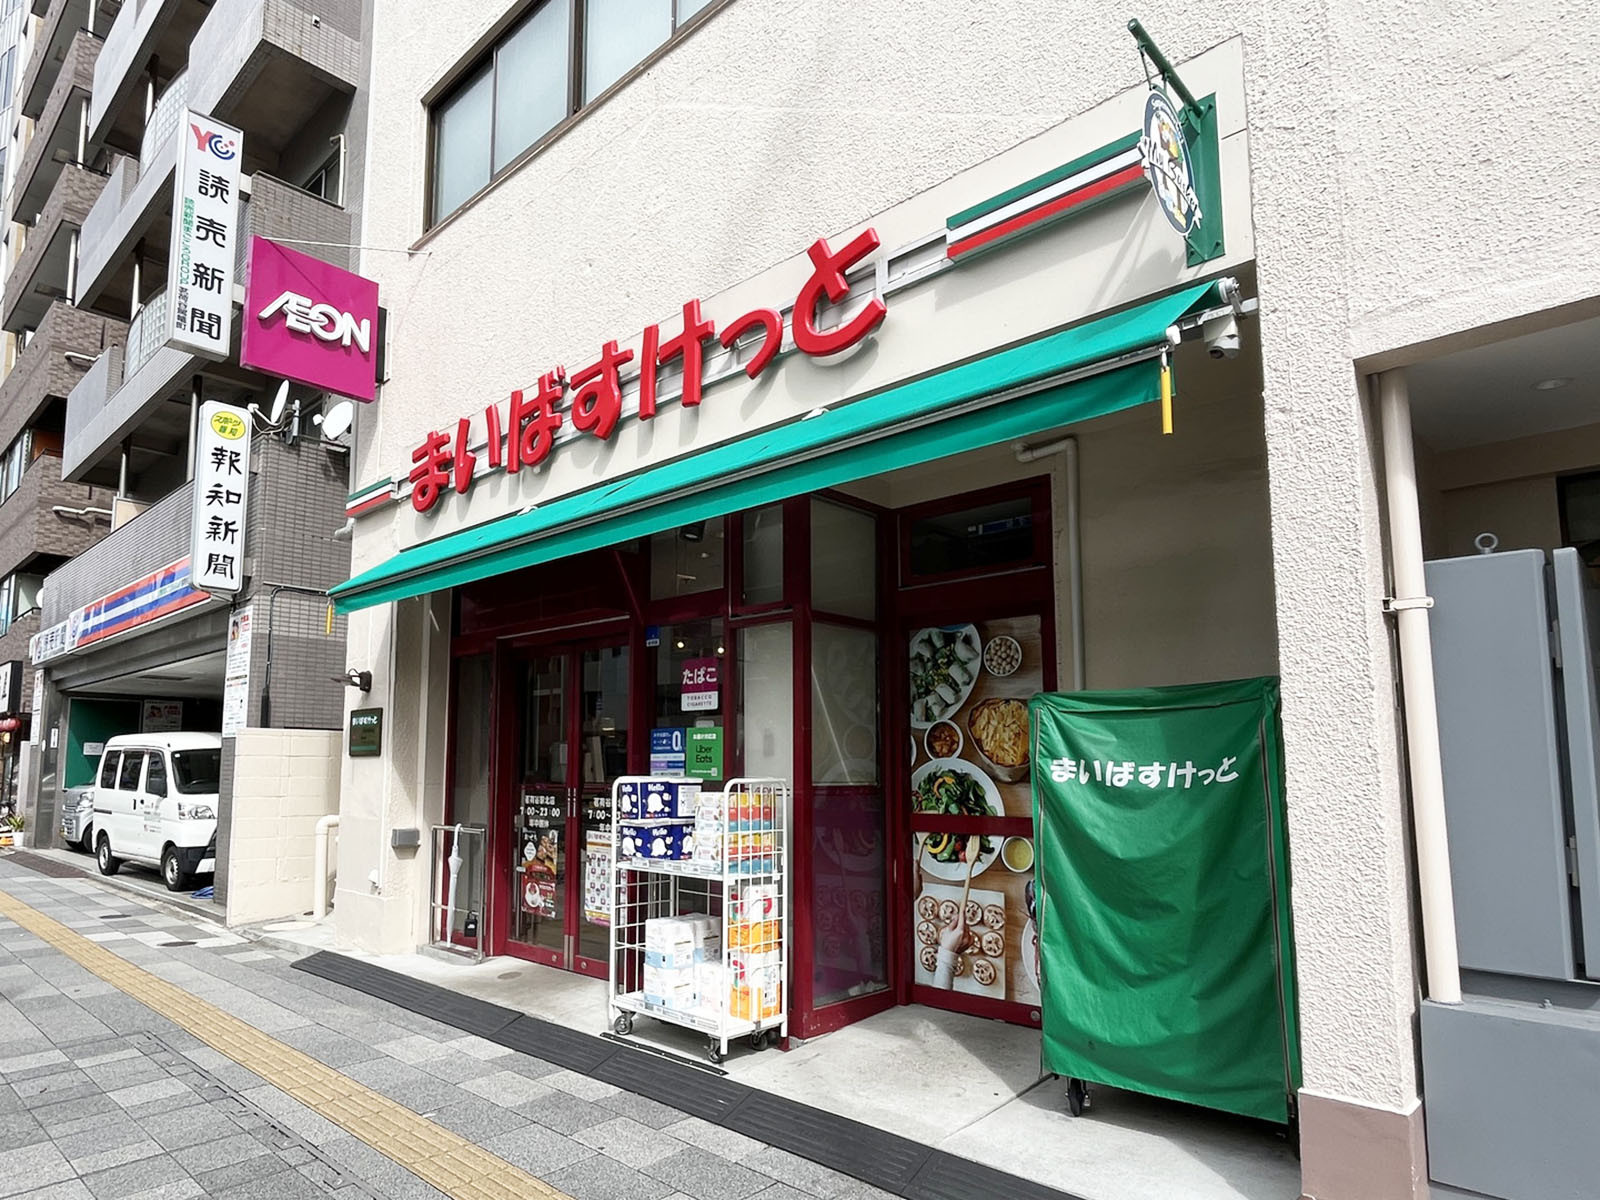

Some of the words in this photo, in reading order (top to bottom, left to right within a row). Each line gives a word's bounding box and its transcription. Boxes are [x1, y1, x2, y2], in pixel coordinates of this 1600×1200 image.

[189, 168, 230, 341] 読売新聞
[257, 290, 371, 353] AEON
[409, 227, 887, 513] まいばすけっと
[204, 446, 242, 580] 報知新聞
[682, 666, 718, 685] たばこ
[695, 744, 713, 754] Uber
[695, 755, 713, 764] Eats
[1050, 756, 1239, 788] まいばすけっと
